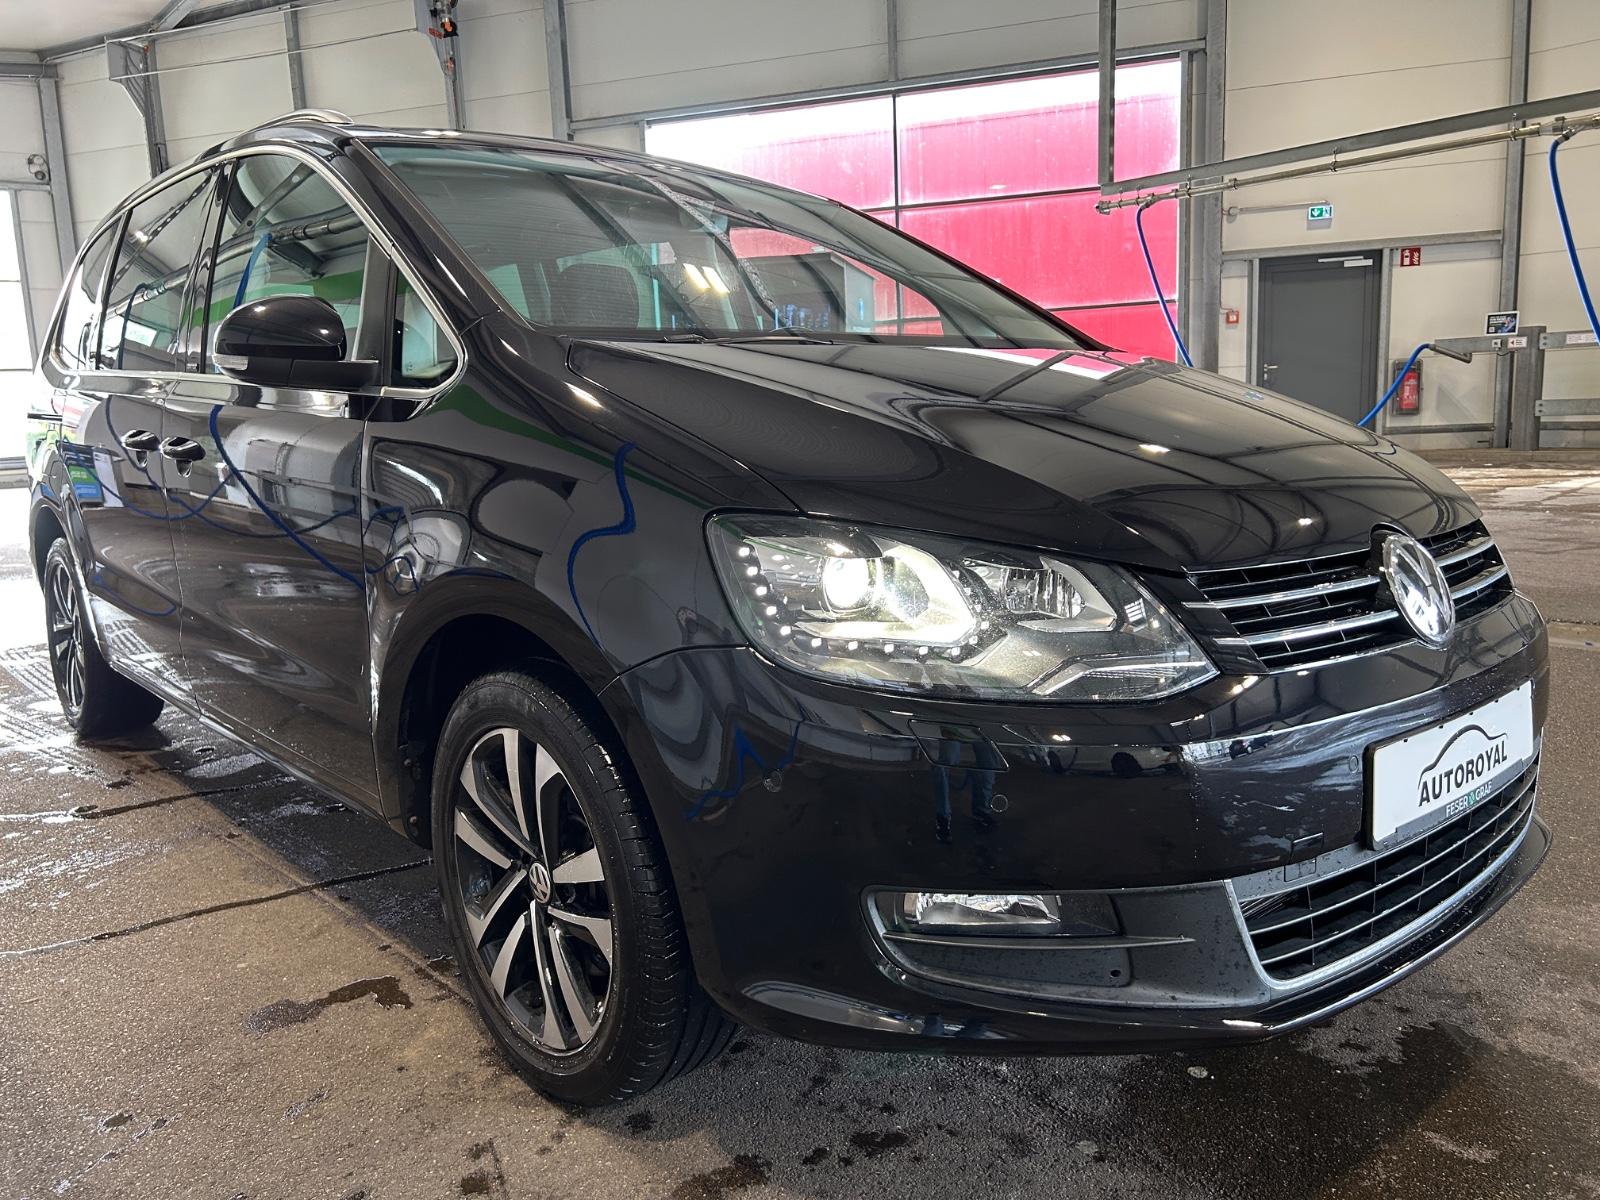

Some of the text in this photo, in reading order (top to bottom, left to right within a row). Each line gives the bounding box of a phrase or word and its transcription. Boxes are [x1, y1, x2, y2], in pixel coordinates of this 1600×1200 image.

[1418, 740, 1508, 808] AUTOROYAL
[1446, 780, 1493, 818] FESER GRAF
